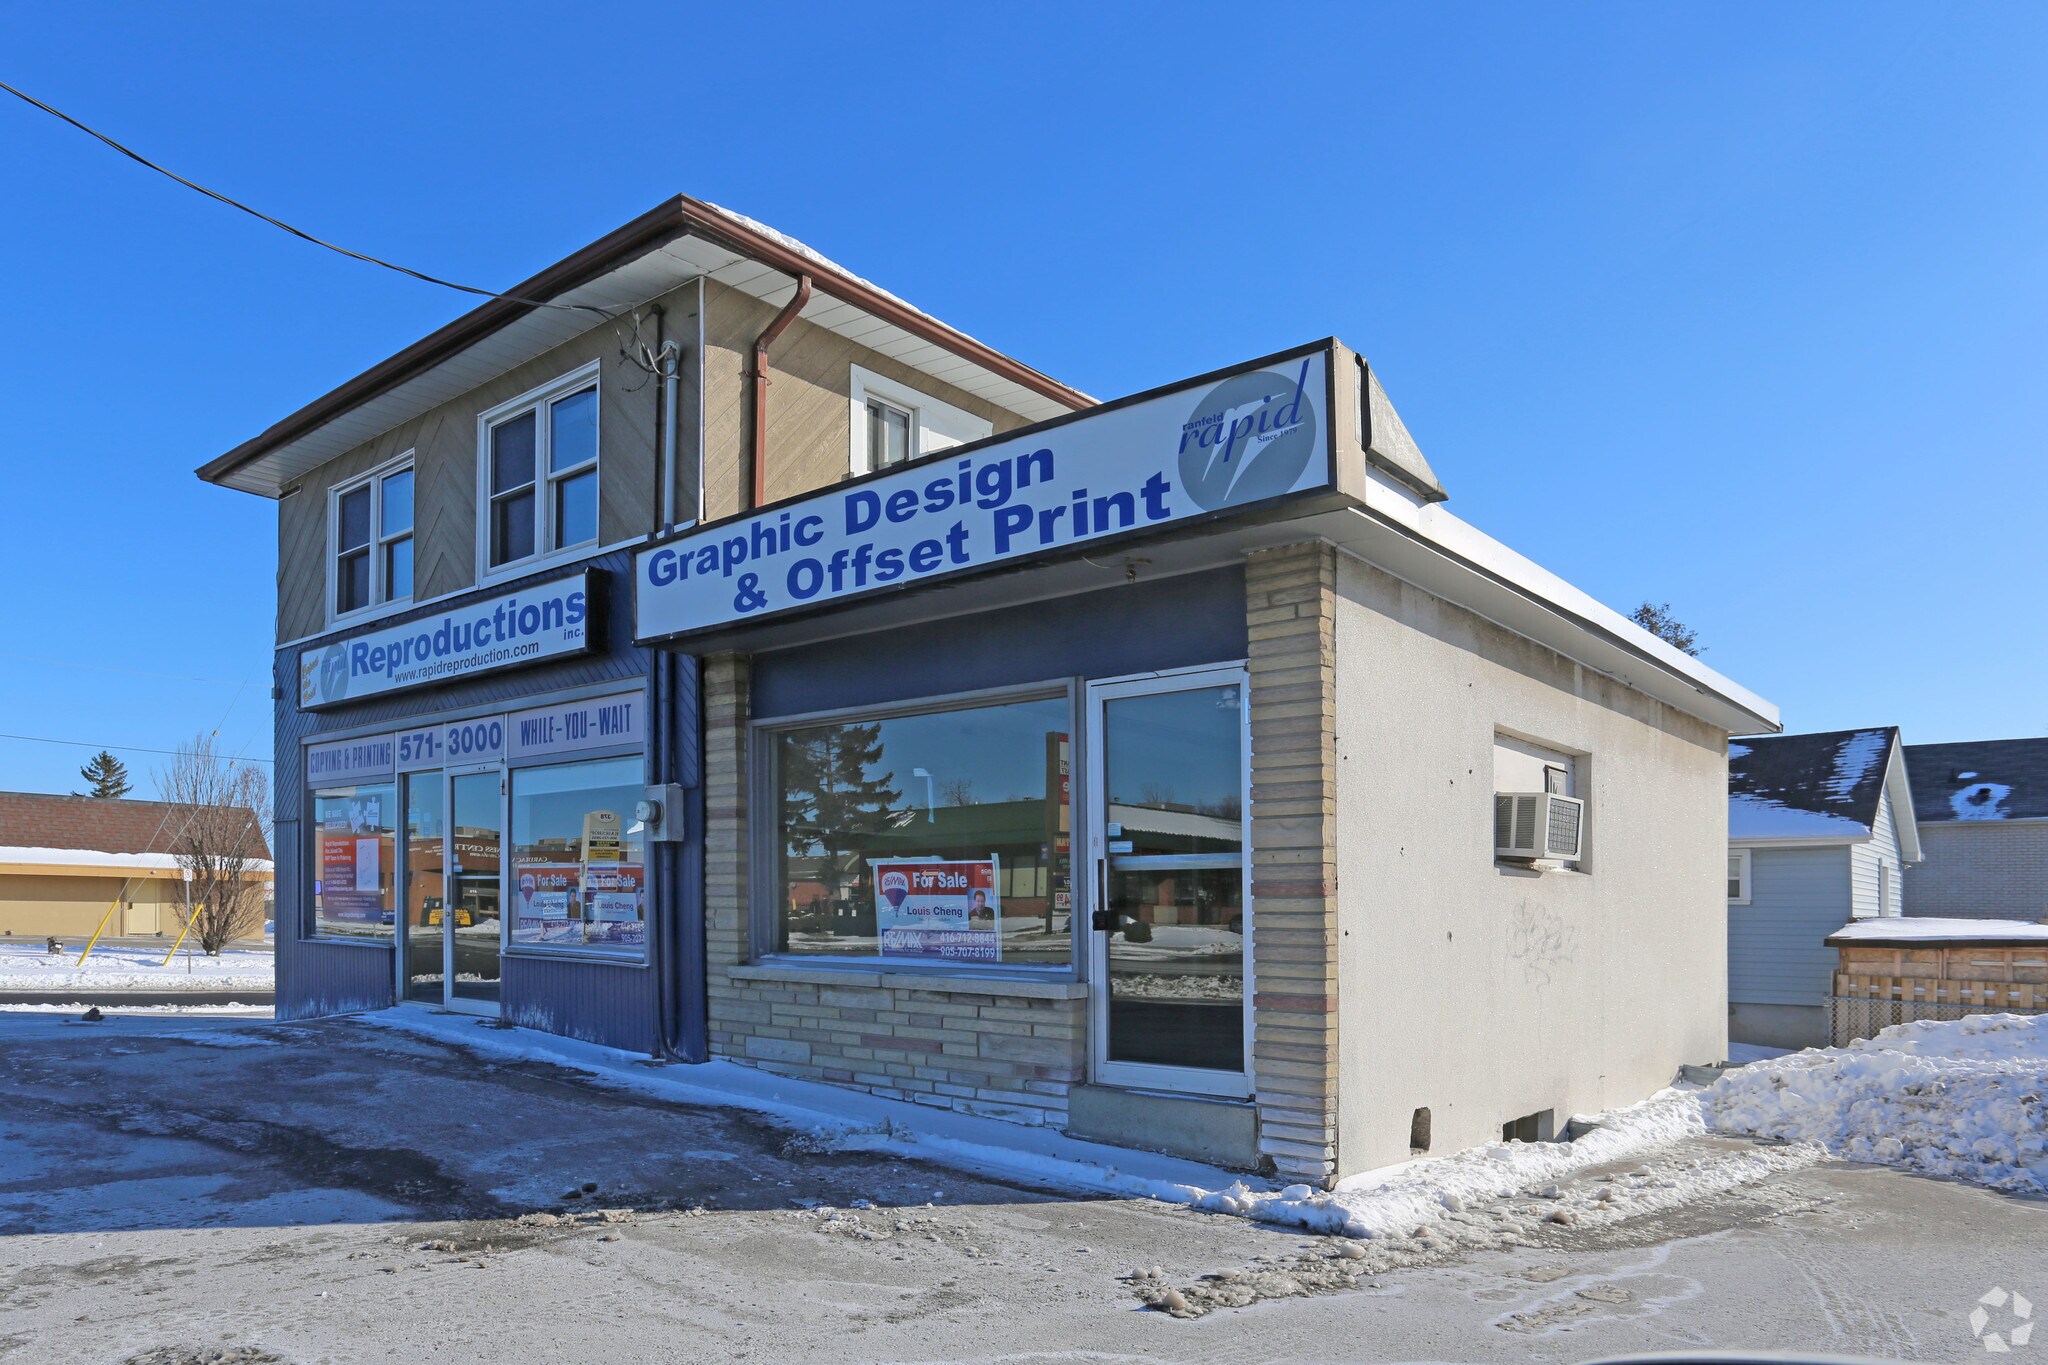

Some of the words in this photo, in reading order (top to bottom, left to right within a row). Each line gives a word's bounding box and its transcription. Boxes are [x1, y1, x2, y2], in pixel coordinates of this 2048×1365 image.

[1179, 358, 1310, 462] rapid
[1183, 412, 1223, 431] ranfeld
[1257, 433, 1278, 443] Since
[1280, 427, 1298, 438] 1979
[648, 512, 824, 587] Graphic
[845, 448, 1054, 536] Design
[733, 572, 768, 613] &
[787, 520, 970, 600] Offset
[993, 471, 1171, 555] Print
[351, 591, 585, 678] Reproductions
[563, 627, 585, 641] inc.
[394, 641, 539, 683] www.rapidreproduction.com
[448, 721, 502, 755] 3000
[310, 751, 341, 774] COPYING
[344, 748, 350, 769] &
[352, 742, 391, 769] PRINTING
[537, 873, 550, 887] For
[551, 873, 567, 887] Sale
[601, 874, 617, 887] For
[617, 873, 636, 888] Sale
[912, 871, 935, 888] For
[938, 871, 968, 888] Sale
[614, 901, 634, 911] Cheng
[907, 906, 931, 916] Louis
[933, 906, 963, 917] Cheng
[940, 946, 996, 958] 905-707-8199
